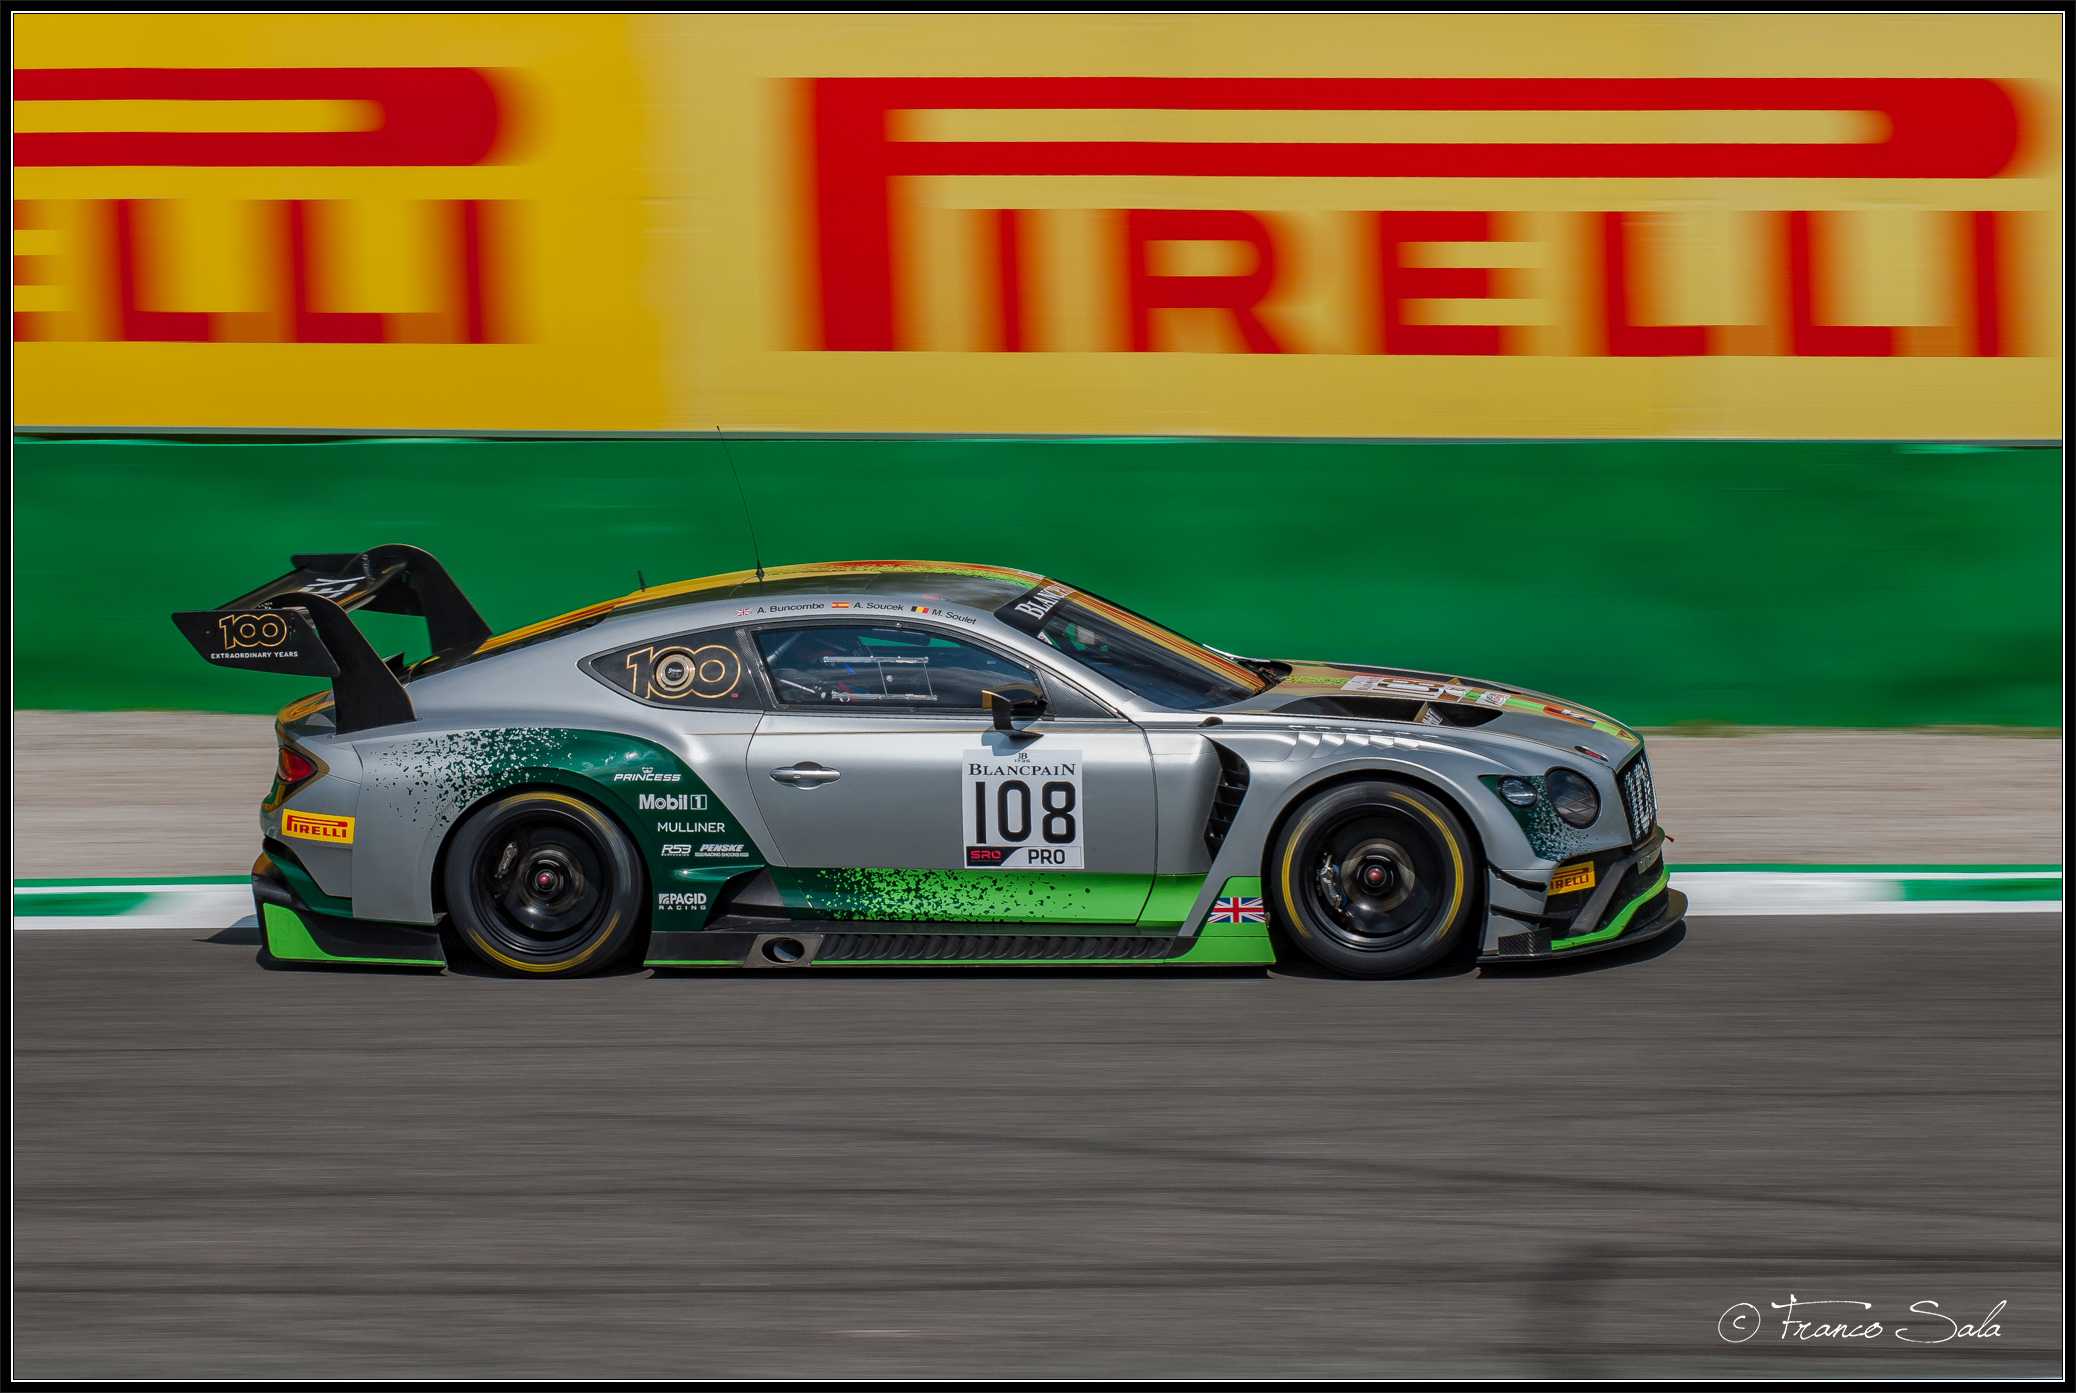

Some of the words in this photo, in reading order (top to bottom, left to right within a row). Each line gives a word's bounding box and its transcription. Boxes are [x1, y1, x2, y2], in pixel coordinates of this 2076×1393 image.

[788, 77, 2034, 358] PIRELLI
[757, 606, 767, 614] A.
[770, 603, 825, 612] Buncombe
[867, 602, 904, 611] Soucek
[932, 609, 942, 617] M.
[945, 612, 977, 625] Soulet
[219, 613, 287, 650] 100
[626, 645, 741, 699] 100
[968, 764, 1077, 775] BLANCPAIN
[614, 774, 681, 782] PRINCESS
[639, 794, 688, 810] Mobil
[975, 779, 1076, 844] 108
[286, 815, 348, 838] PIRELLI
[657, 822, 725, 833] MULLINER
[700, 844, 744, 852] PENSKE
[970, 850, 1001, 859] SRO
[1028, 849, 1066, 864] PRO
[670, 893, 707, 904] PAGID
